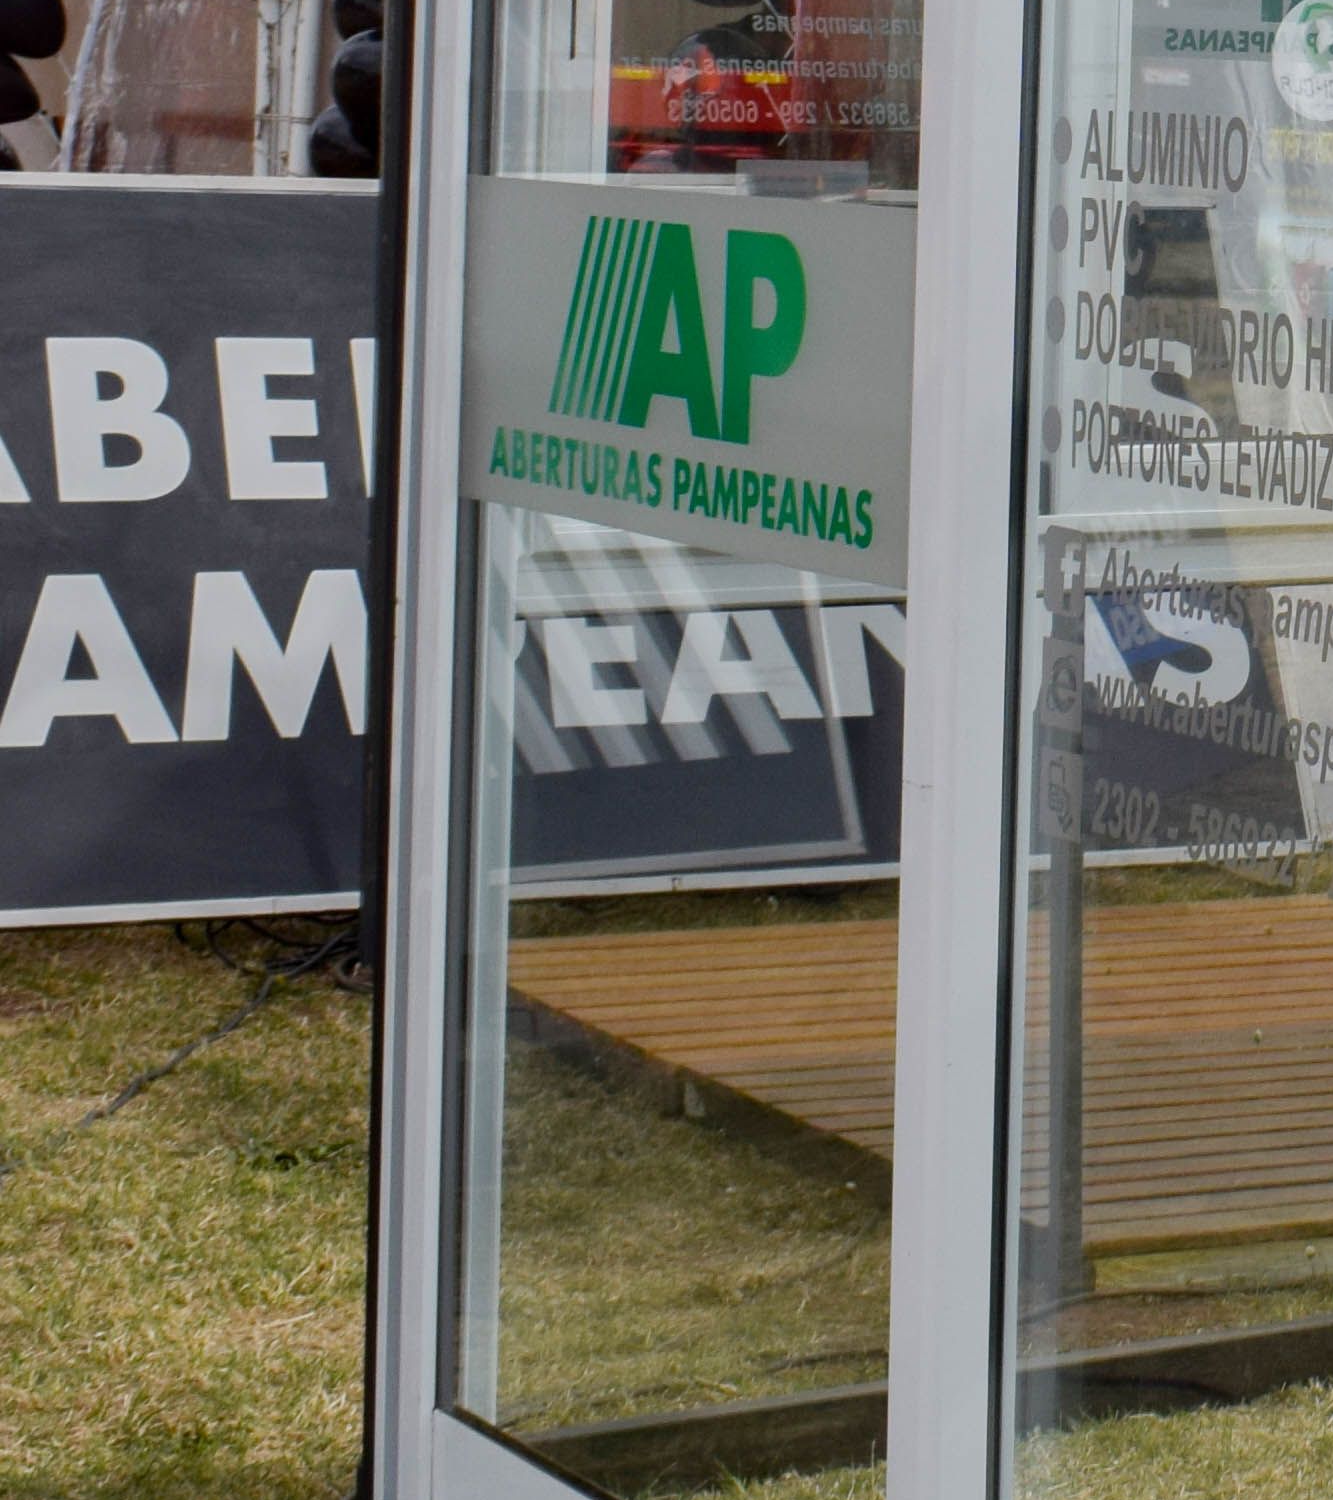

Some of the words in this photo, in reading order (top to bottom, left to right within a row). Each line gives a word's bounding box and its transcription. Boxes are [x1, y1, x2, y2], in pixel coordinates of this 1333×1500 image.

[1080, 108, 1248, 192] ALUMINIO
[1079, 197, 1146, 277] PVC
[1075, 291, 1175, 374] DOBLE
[1071, 399, 1211, 492] PORTONES
[489, 426, 662, 507] ABERTURAS
[674, 457, 873, 549] PAMPEANAS
[1100, 547, 1247, 629] Aberturas
[1091, 778, 1160, 848] 2302
